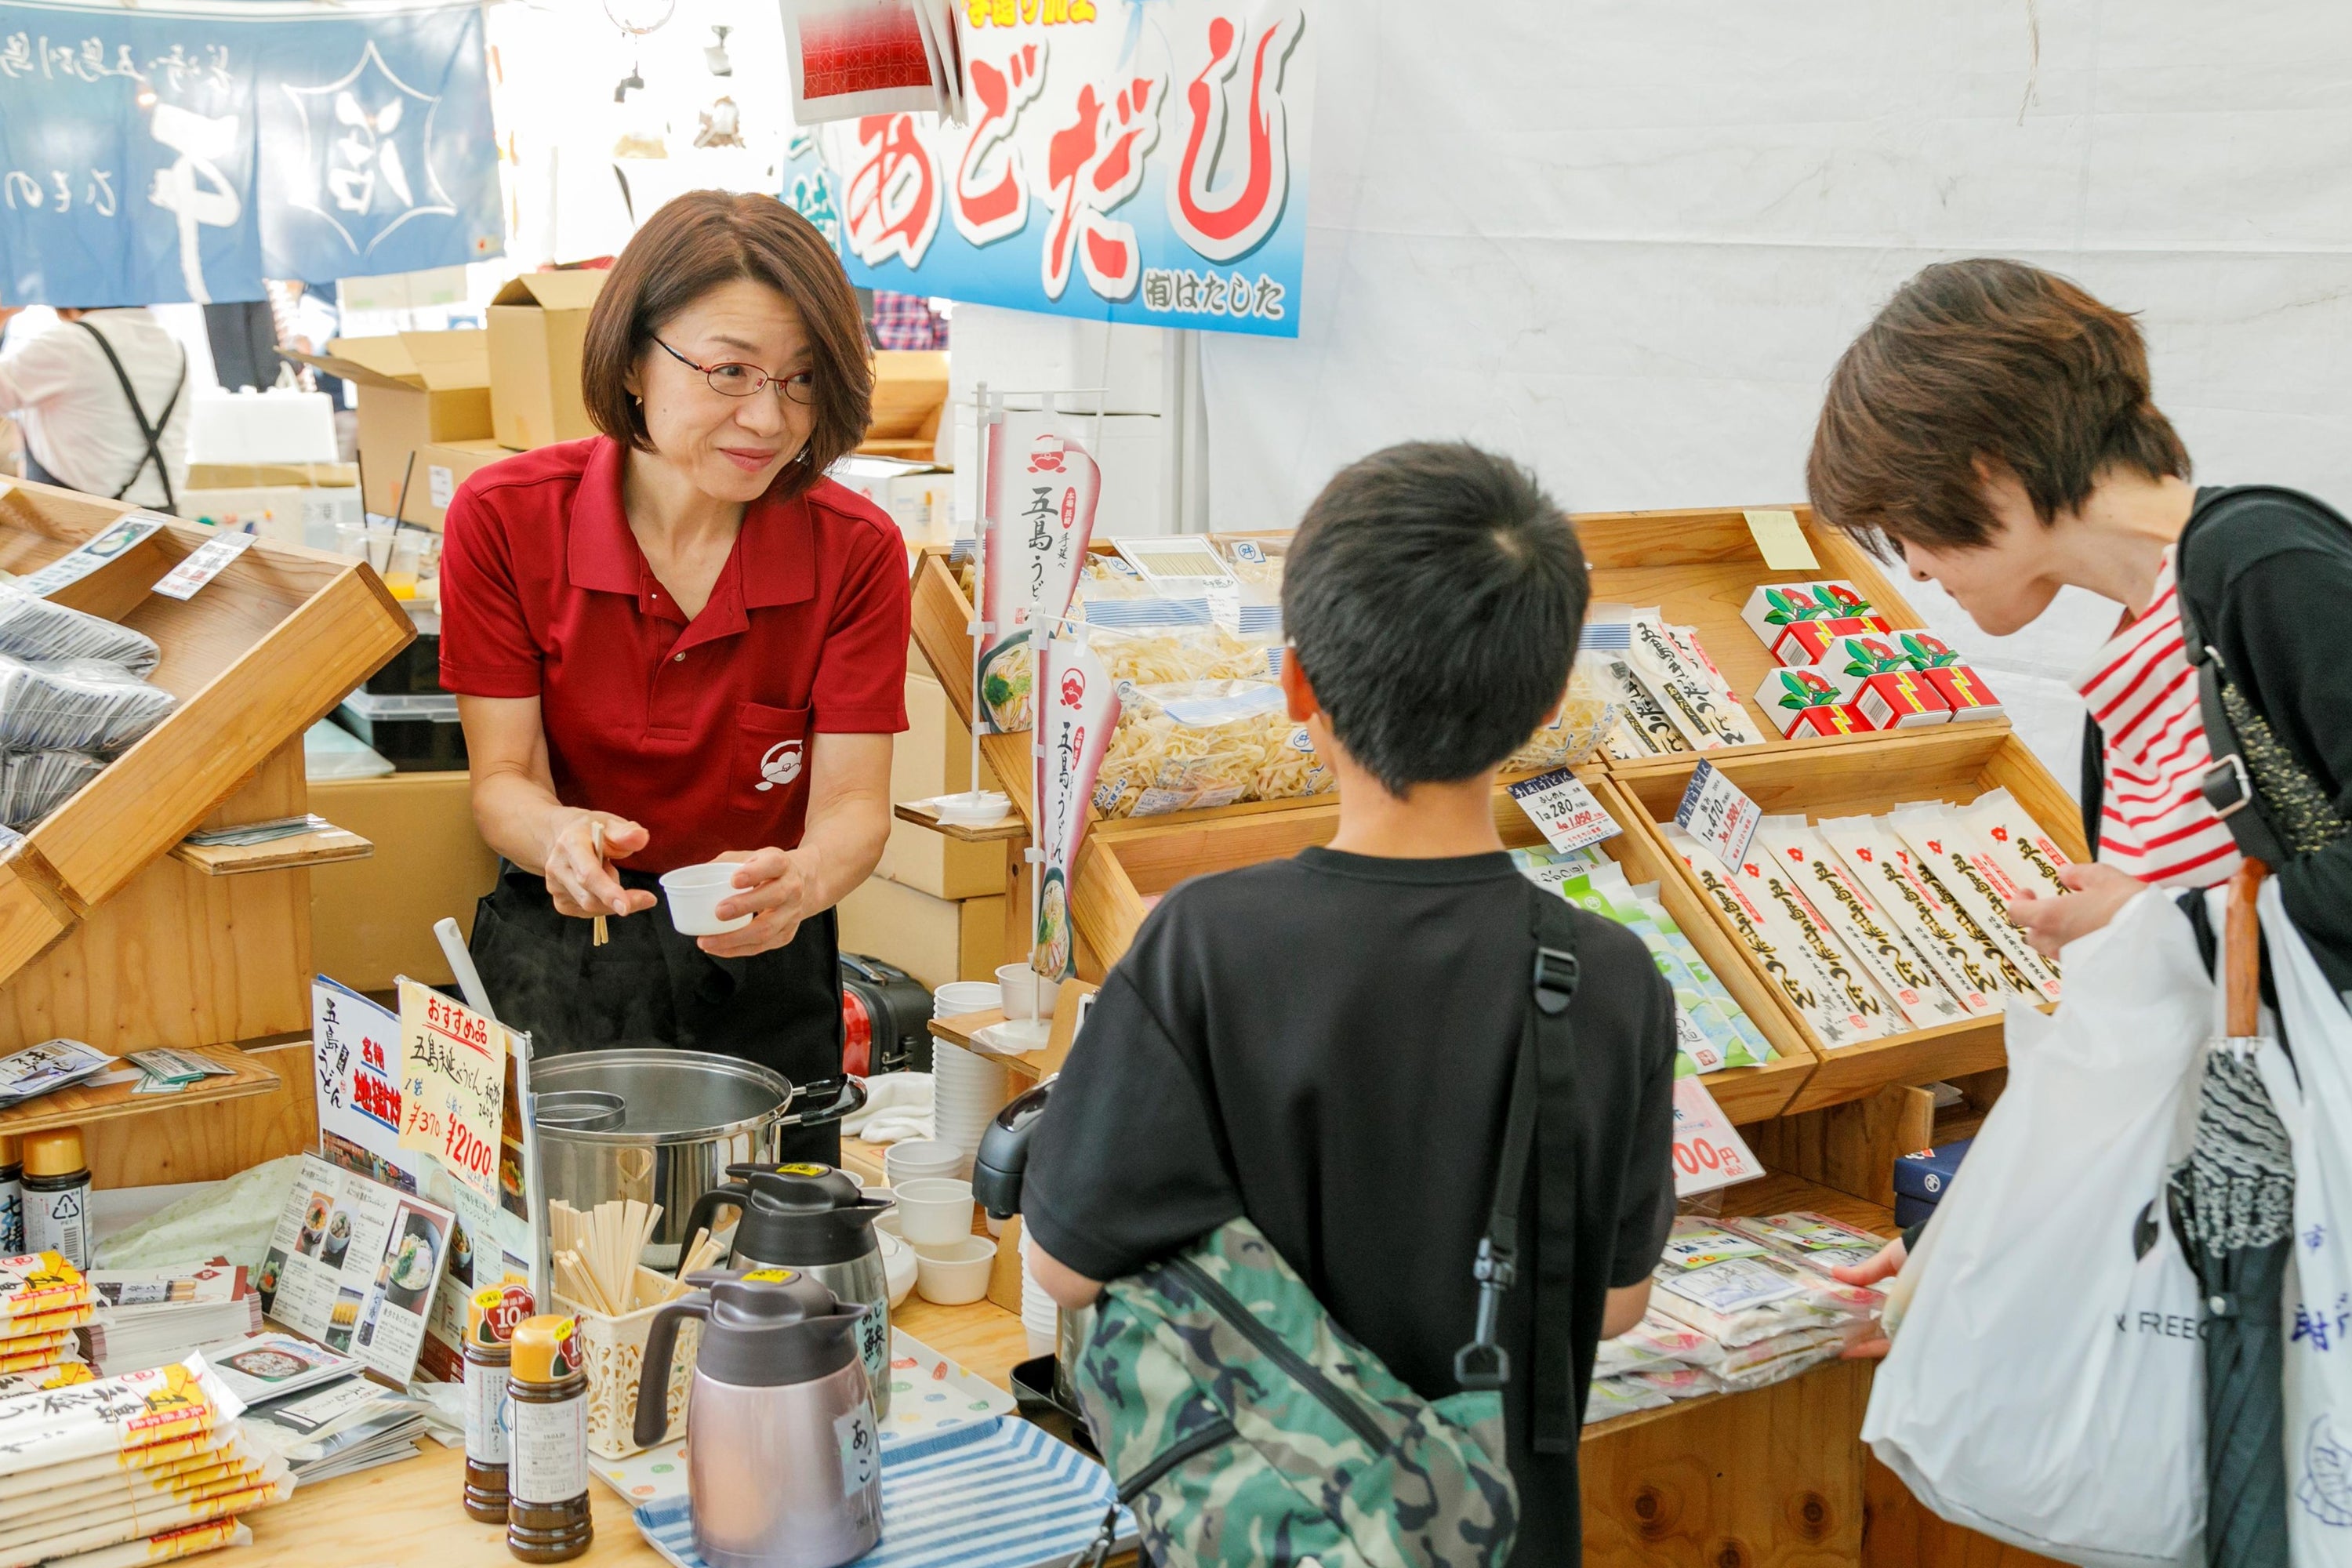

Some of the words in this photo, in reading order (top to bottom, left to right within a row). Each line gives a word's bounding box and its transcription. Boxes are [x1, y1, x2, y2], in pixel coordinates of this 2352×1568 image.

[846, 13, 1287, 287] あごだし
[1021, 486, 1059, 622] 五島うど
[1058, 532, 1069, 568] 手延べ
[1512, 771, 1573, 798] 手延うどん
[428, 995, 488, 1045] おすすめ品
[361, 1036, 385, 1071] 名物
[1671, 1137, 1740, 1174] 00円
[852, 1419, 873, 1483] あご
